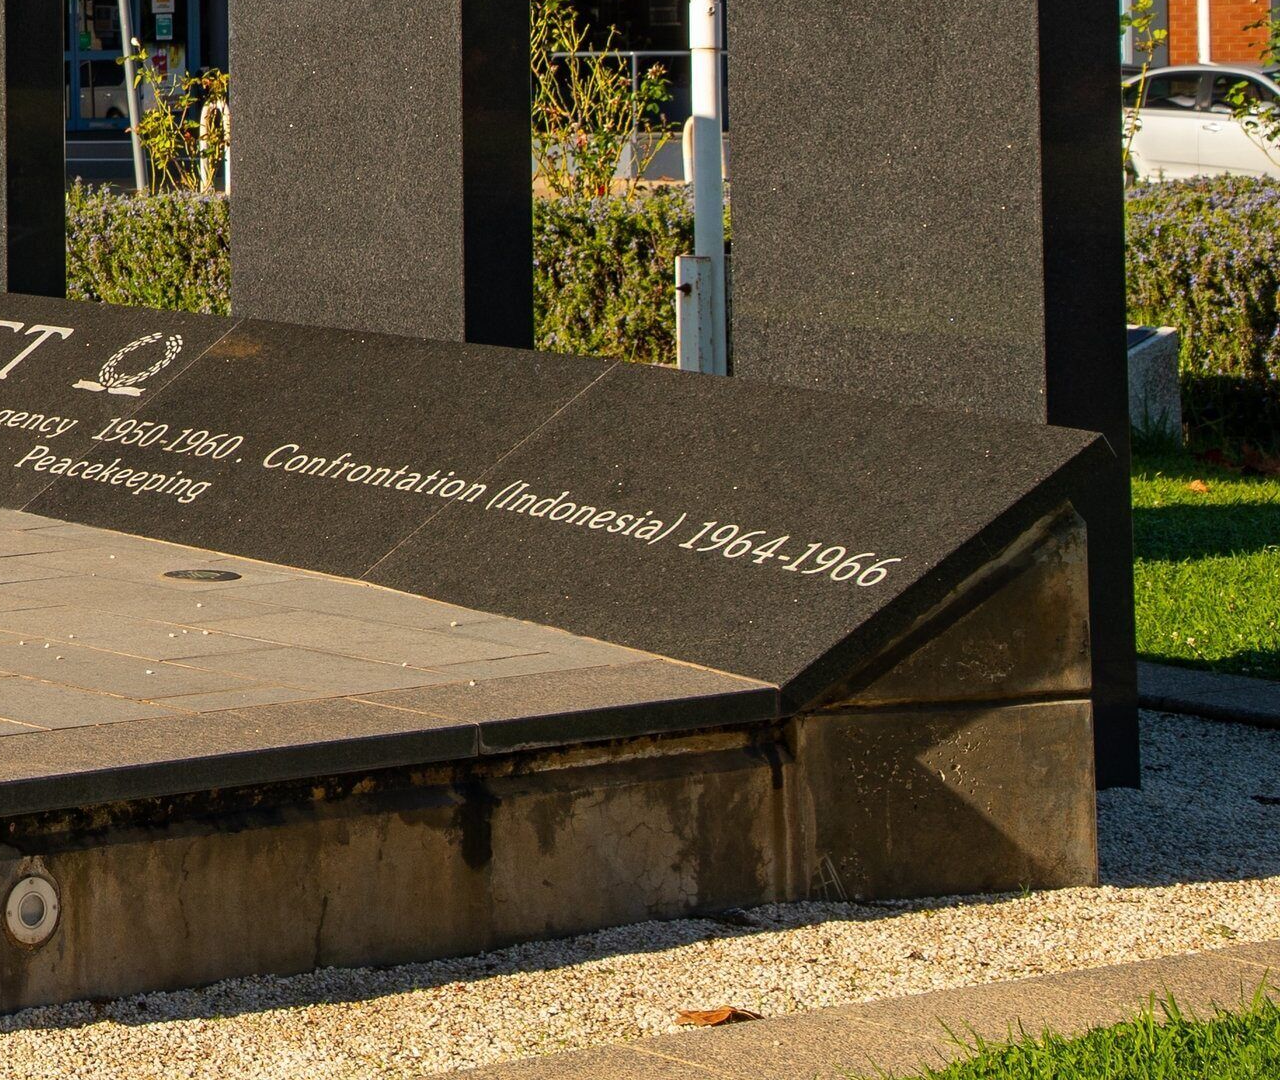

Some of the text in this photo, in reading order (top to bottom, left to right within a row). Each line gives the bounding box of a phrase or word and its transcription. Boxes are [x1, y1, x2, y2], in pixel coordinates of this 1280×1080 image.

[14, 445, 212, 504] Peacekeeping
[263, 443, 487, 502] Confrontation
[485, 481, 687, 546] (Indonesia)
[678, 521, 902, 587] 1964-1966
